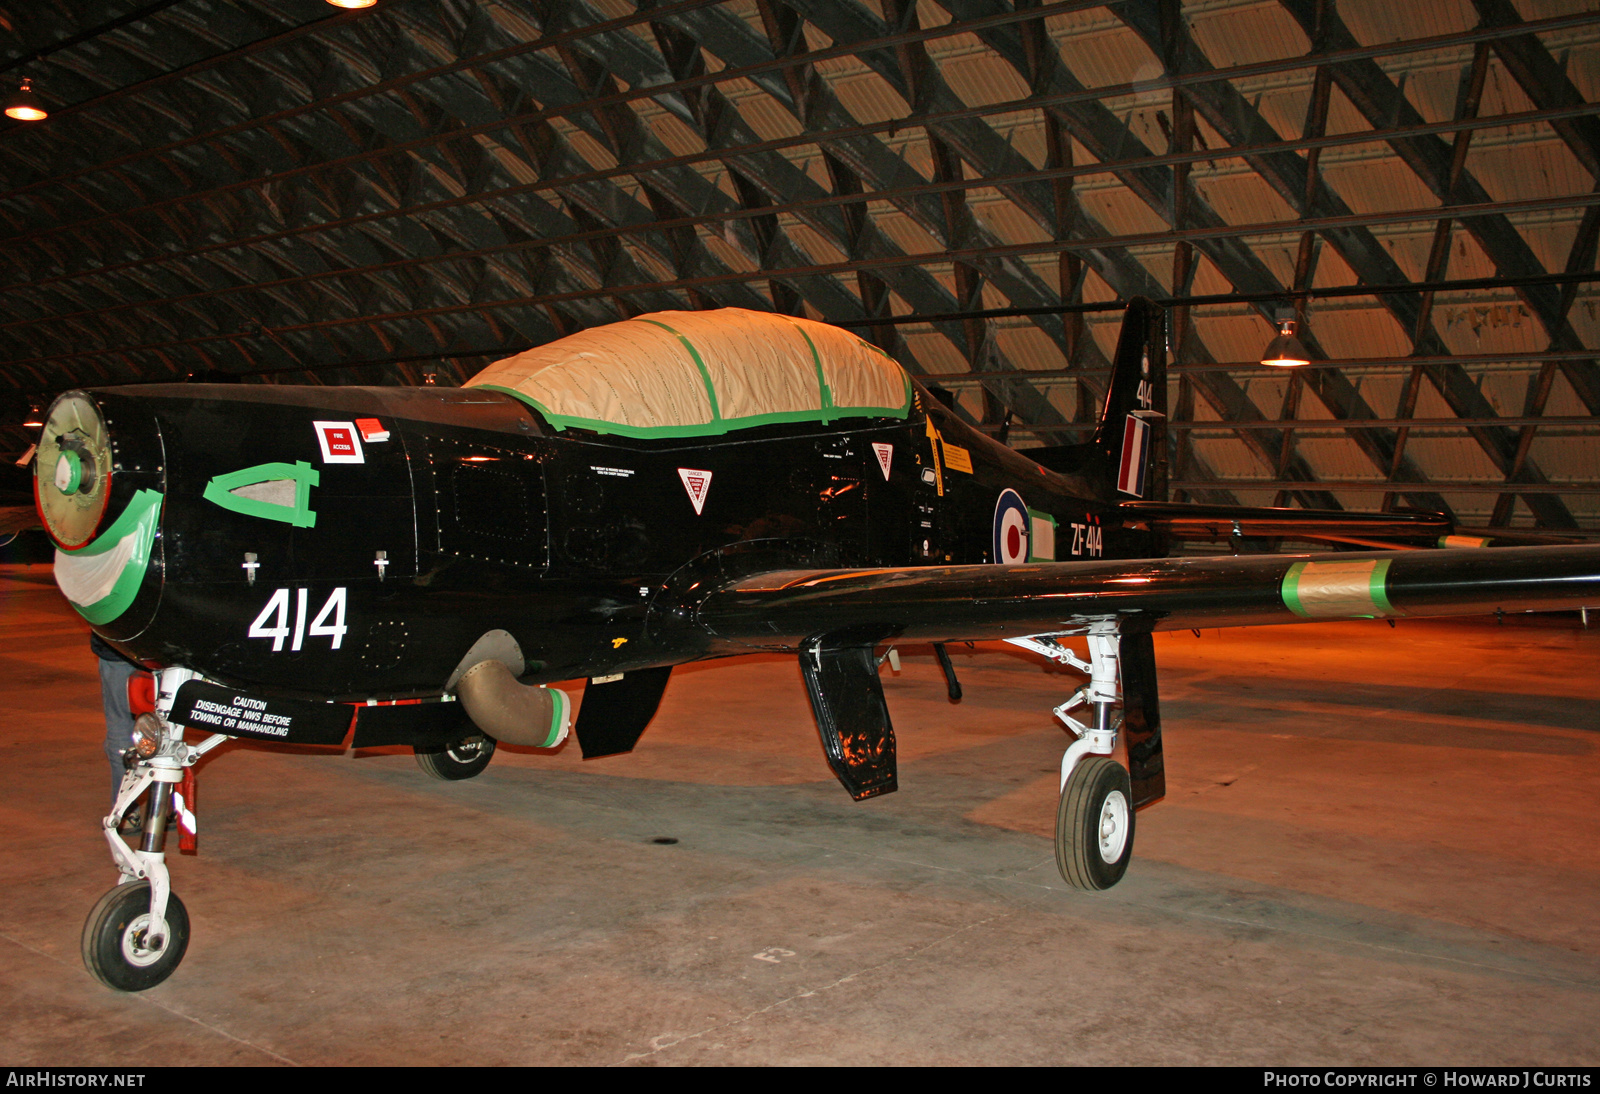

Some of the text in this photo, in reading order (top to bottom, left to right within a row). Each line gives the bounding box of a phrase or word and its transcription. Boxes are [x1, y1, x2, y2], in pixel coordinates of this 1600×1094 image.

[1136, 379, 1153, 411] 414
[248, 587, 348, 652] 414
[195, 700, 292, 726] DISENGAGE NWS BEFORE
[233, 696, 267, 711] CAUTION
[190, 709, 288, 736] TOWING OR MANHANDLING
